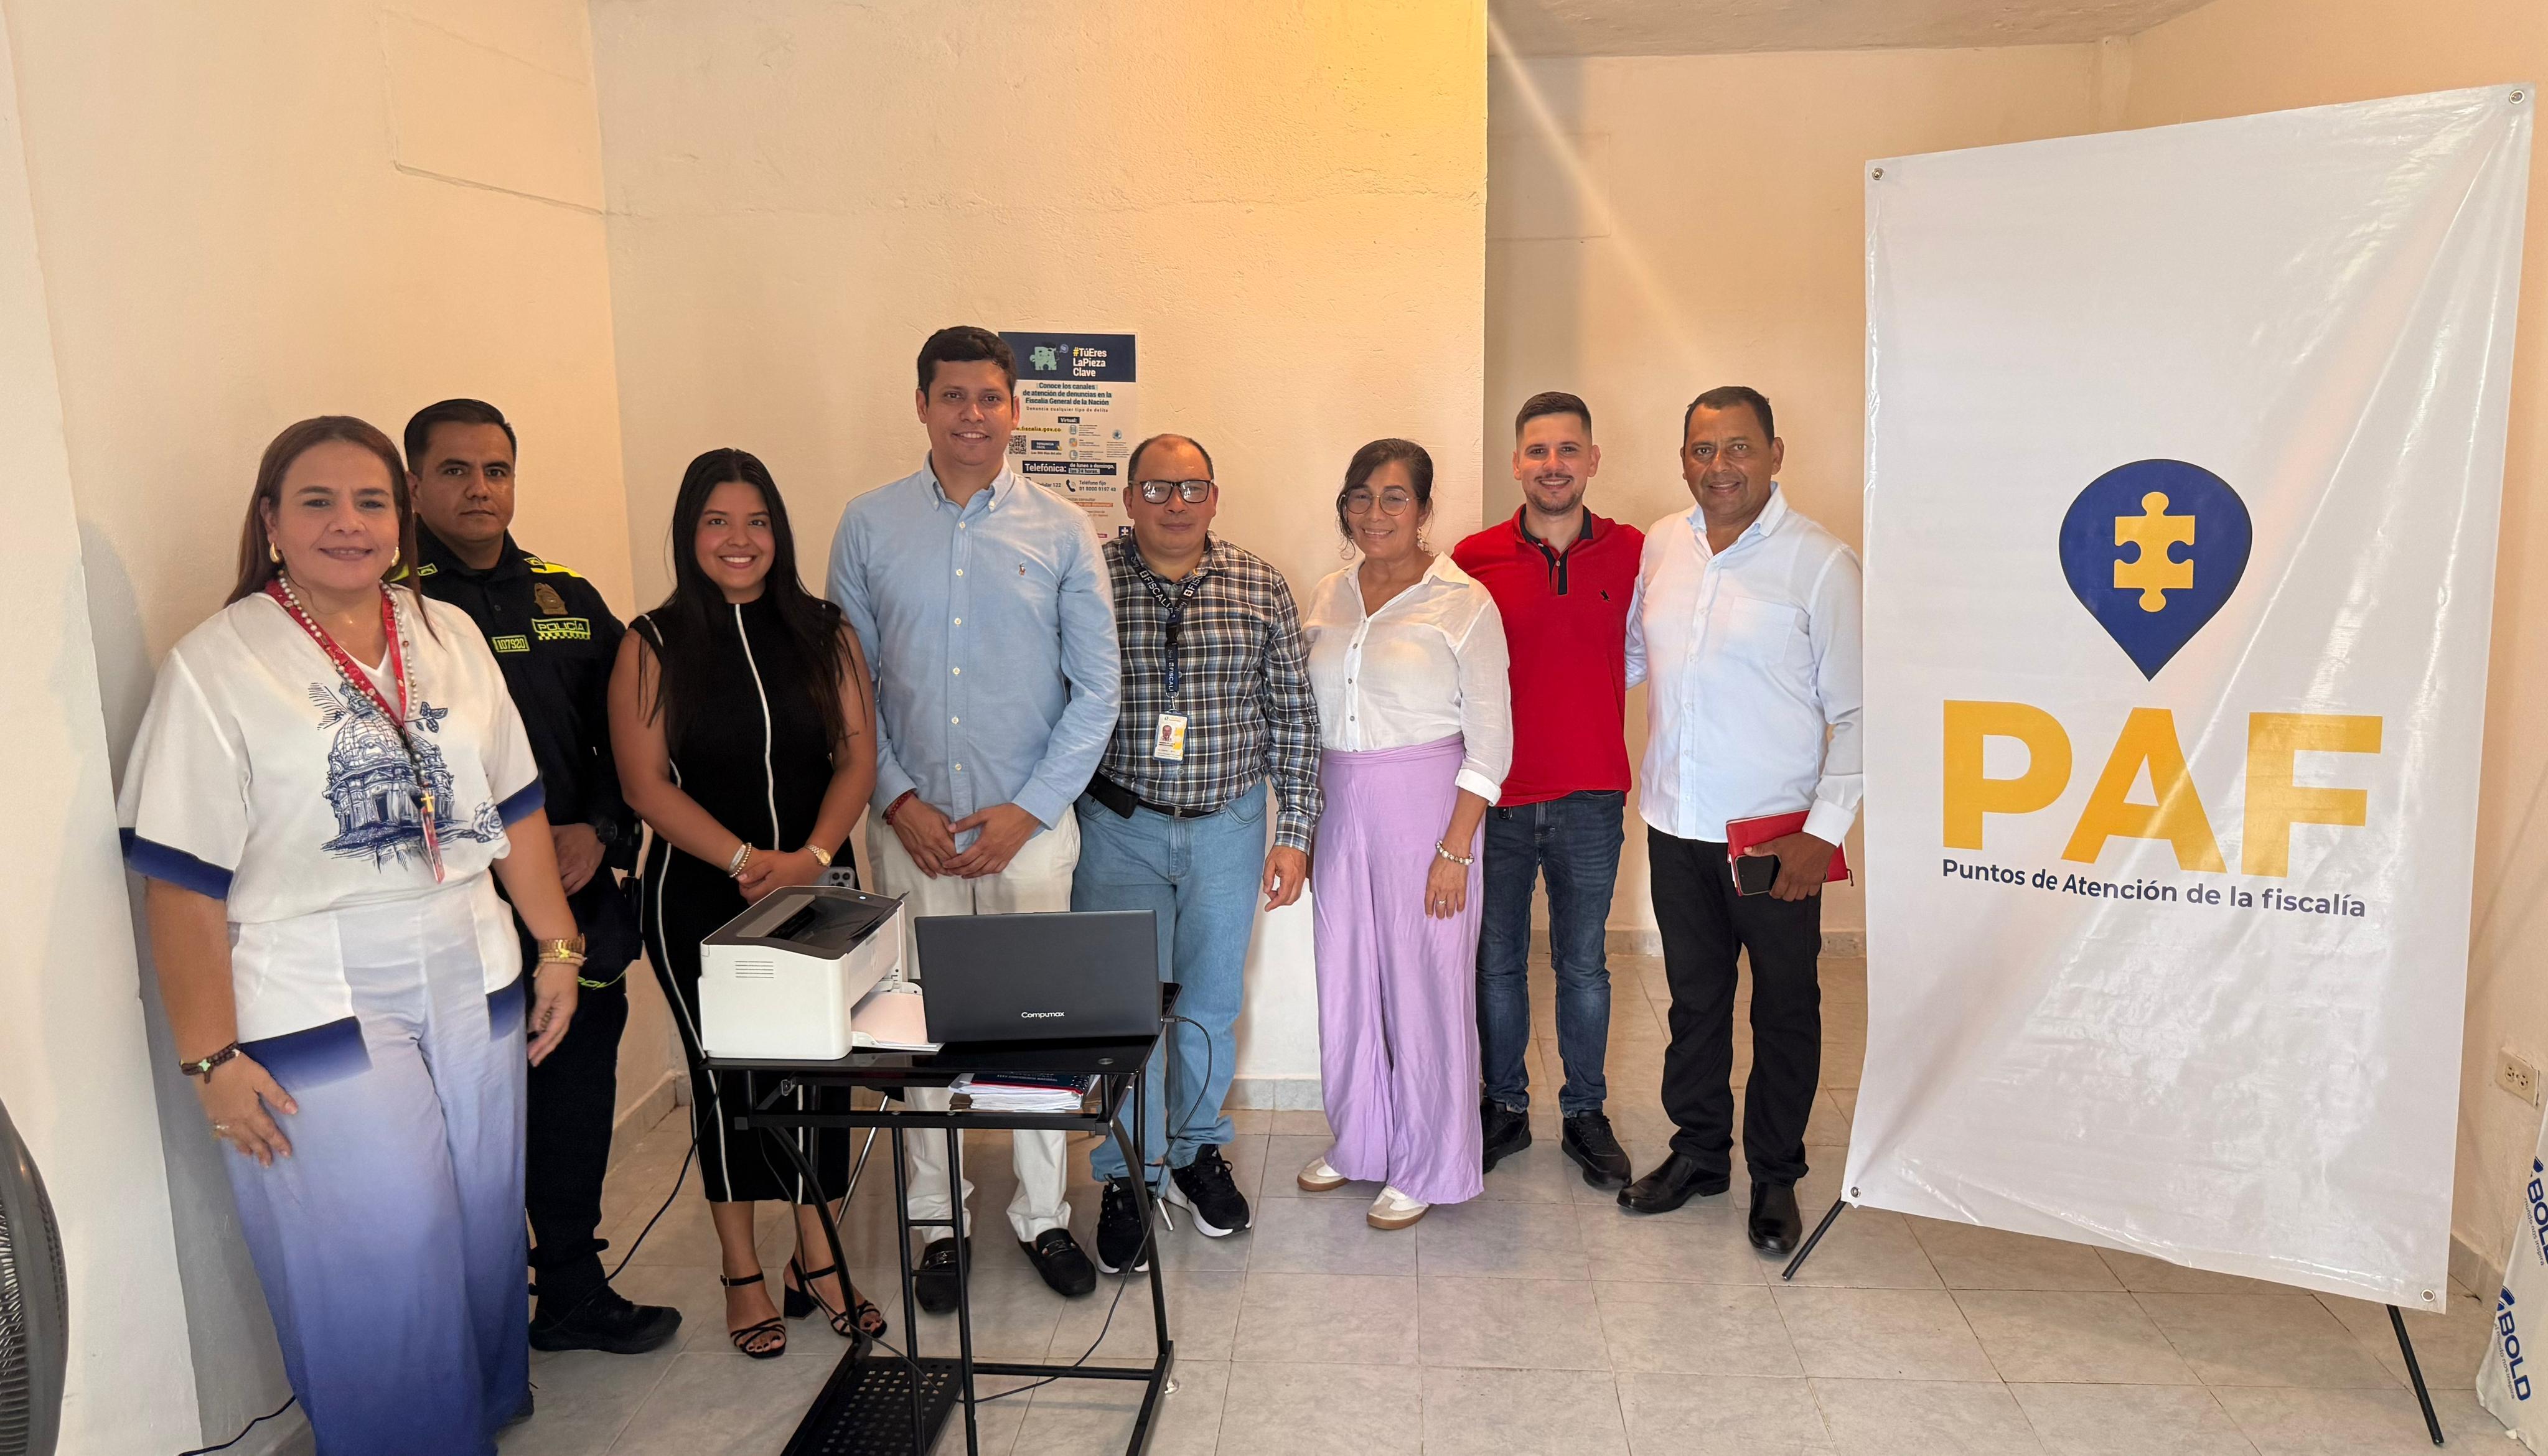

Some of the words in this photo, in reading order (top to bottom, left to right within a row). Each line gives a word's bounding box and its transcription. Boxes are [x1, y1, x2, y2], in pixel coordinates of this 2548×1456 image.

[1073, 347, 1107, 357] #TúEres
[1073, 357, 1106, 367] LaPieza
[1073, 367, 1096, 377] Clave
[1024, 463, 1067, 472] Telefónica:
[538, 620, 585, 631] POLICÍA
[1943, 699, 2383, 878] PAF
[1942, 859, 2026, 887] Puntos
[2031, 869, 2058, 890] de
[2062, 874, 2177, 903] Atención
[2186, 883, 2221, 906] de
[2230, 885, 2253, 908] la
[2262, 889, 2366, 918] fiscalía
[2527, 1178, 2548, 1265] BOL
[2498, 1310, 2531, 1401] BOLD
